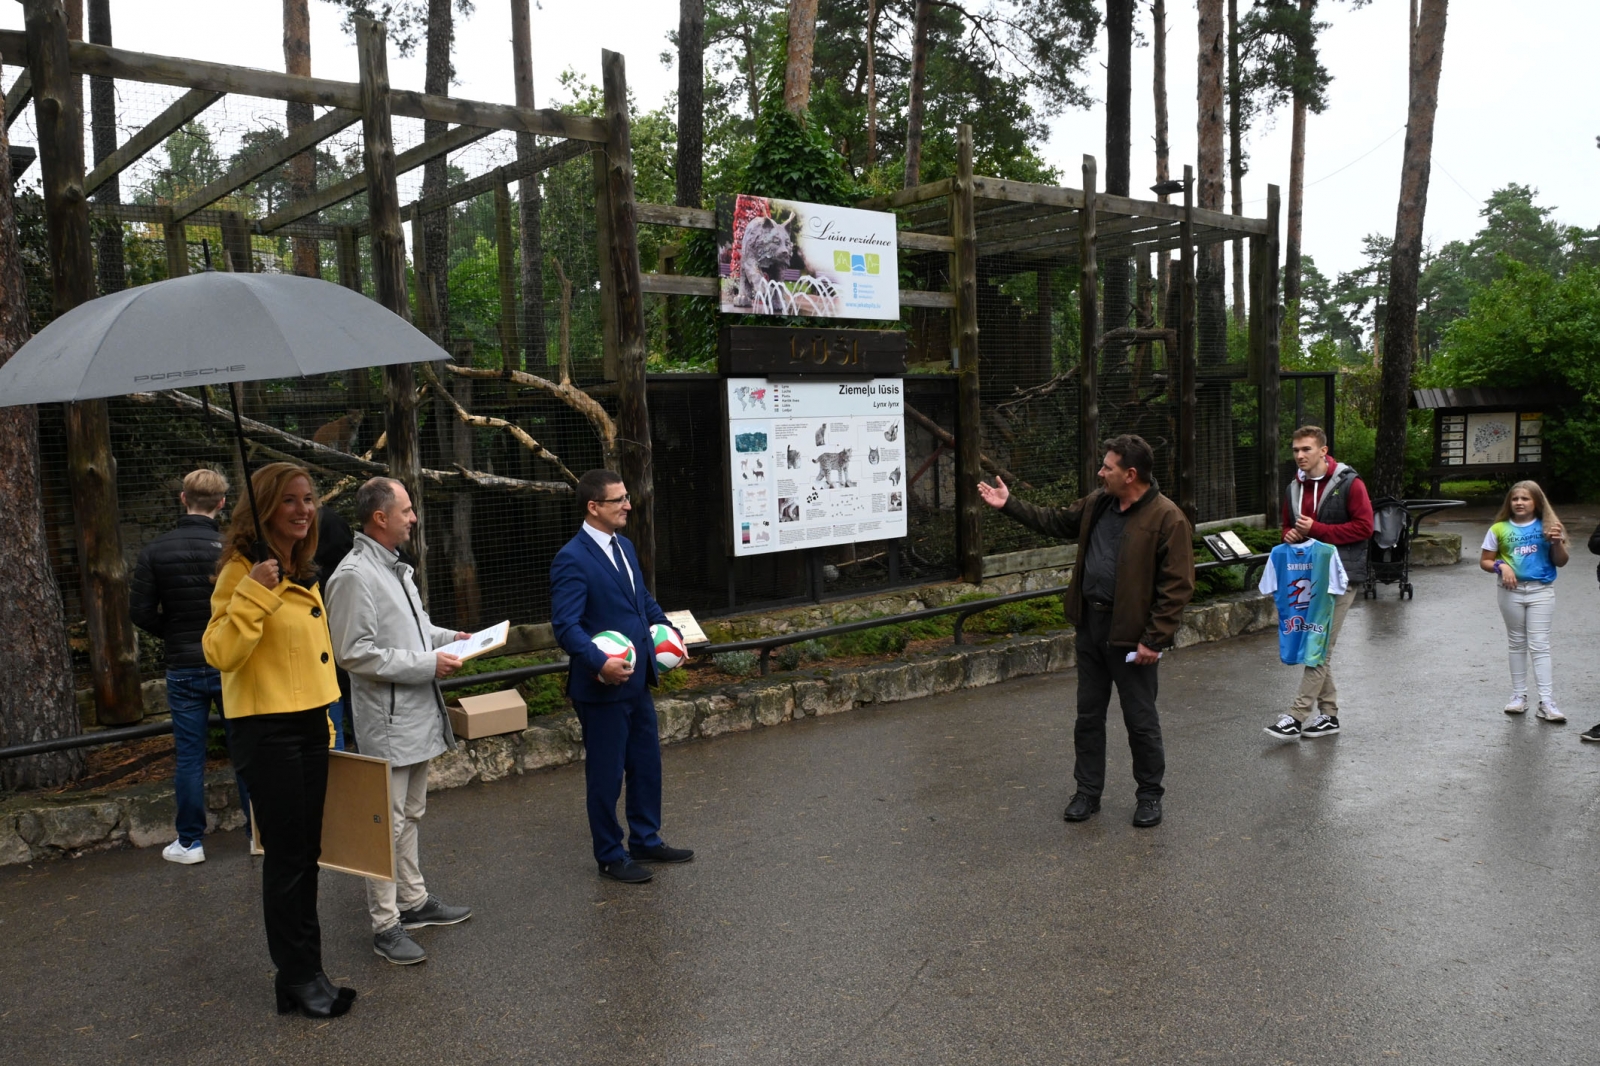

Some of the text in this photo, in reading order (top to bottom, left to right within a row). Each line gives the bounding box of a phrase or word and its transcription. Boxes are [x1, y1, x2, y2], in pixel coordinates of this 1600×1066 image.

[802, 216, 892, 247] Lūšu rezidence
[133, 364, 246, 382] PORSCHE
[838, 384, 900, 397] Ziemeļu lūsis
[873, 400, 900, 409] Lynx lynx
[1513, 544, 1538, 555] FANS
